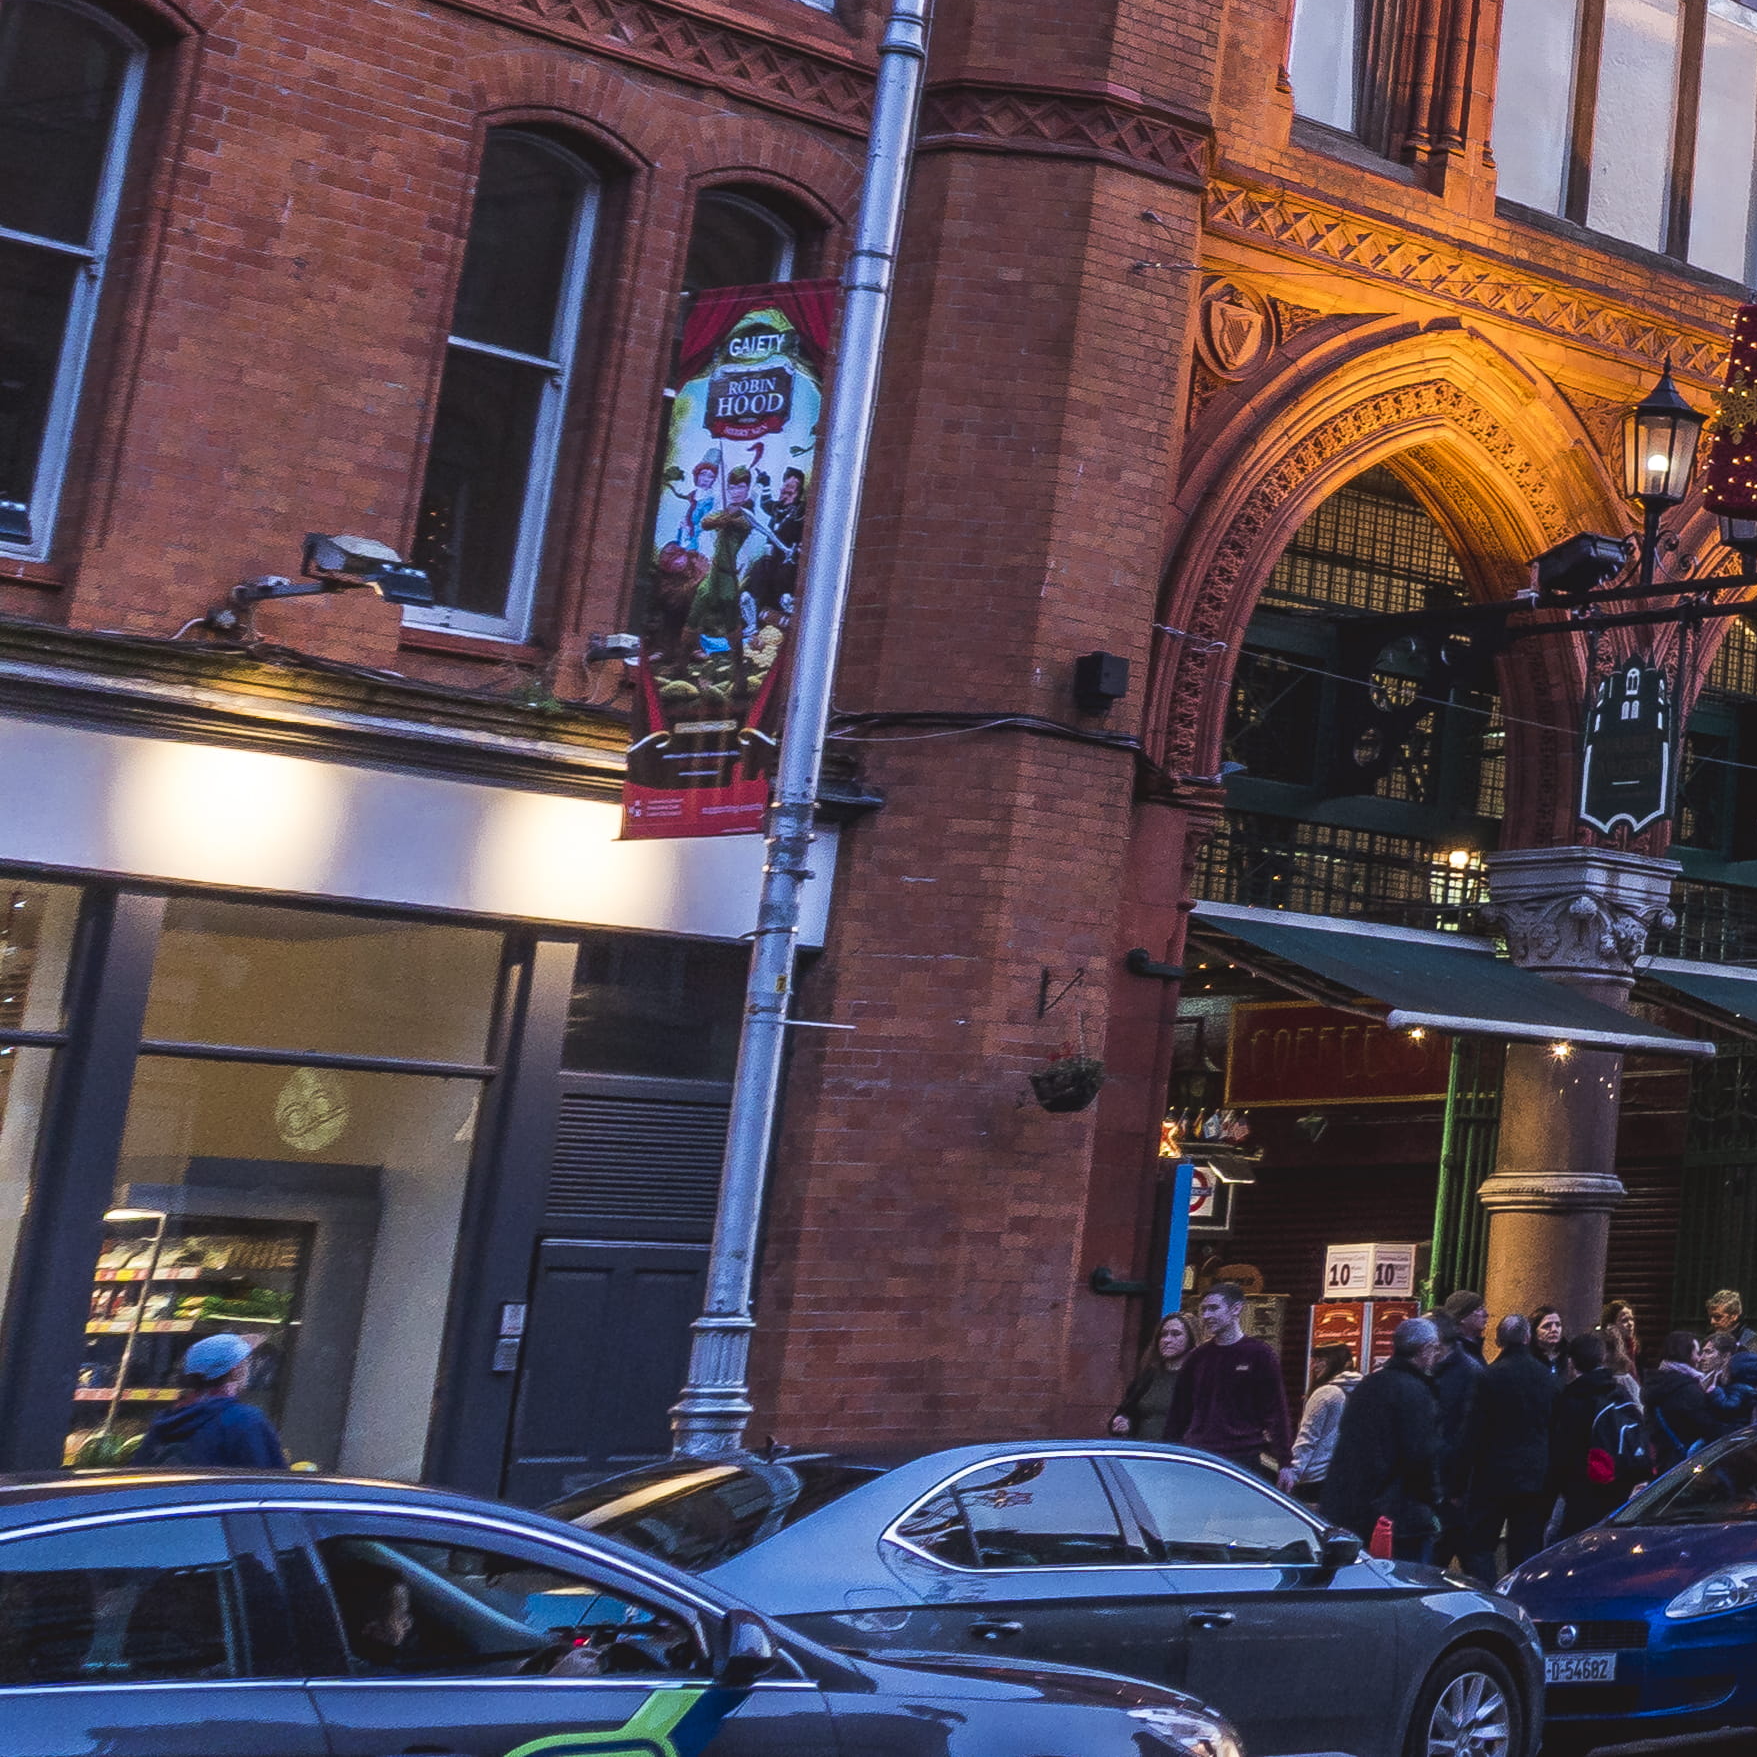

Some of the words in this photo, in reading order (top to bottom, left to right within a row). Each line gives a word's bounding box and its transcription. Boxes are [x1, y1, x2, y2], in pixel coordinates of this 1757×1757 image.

[729, 333, 785, 357] GAIETY
[728, 377, 777, 395] ROBIN
[715, 392, 784, 417] HOOD
[1329, 1263, 1351, 1286] 10
[1374, 1263, 1395, 1285] 10
